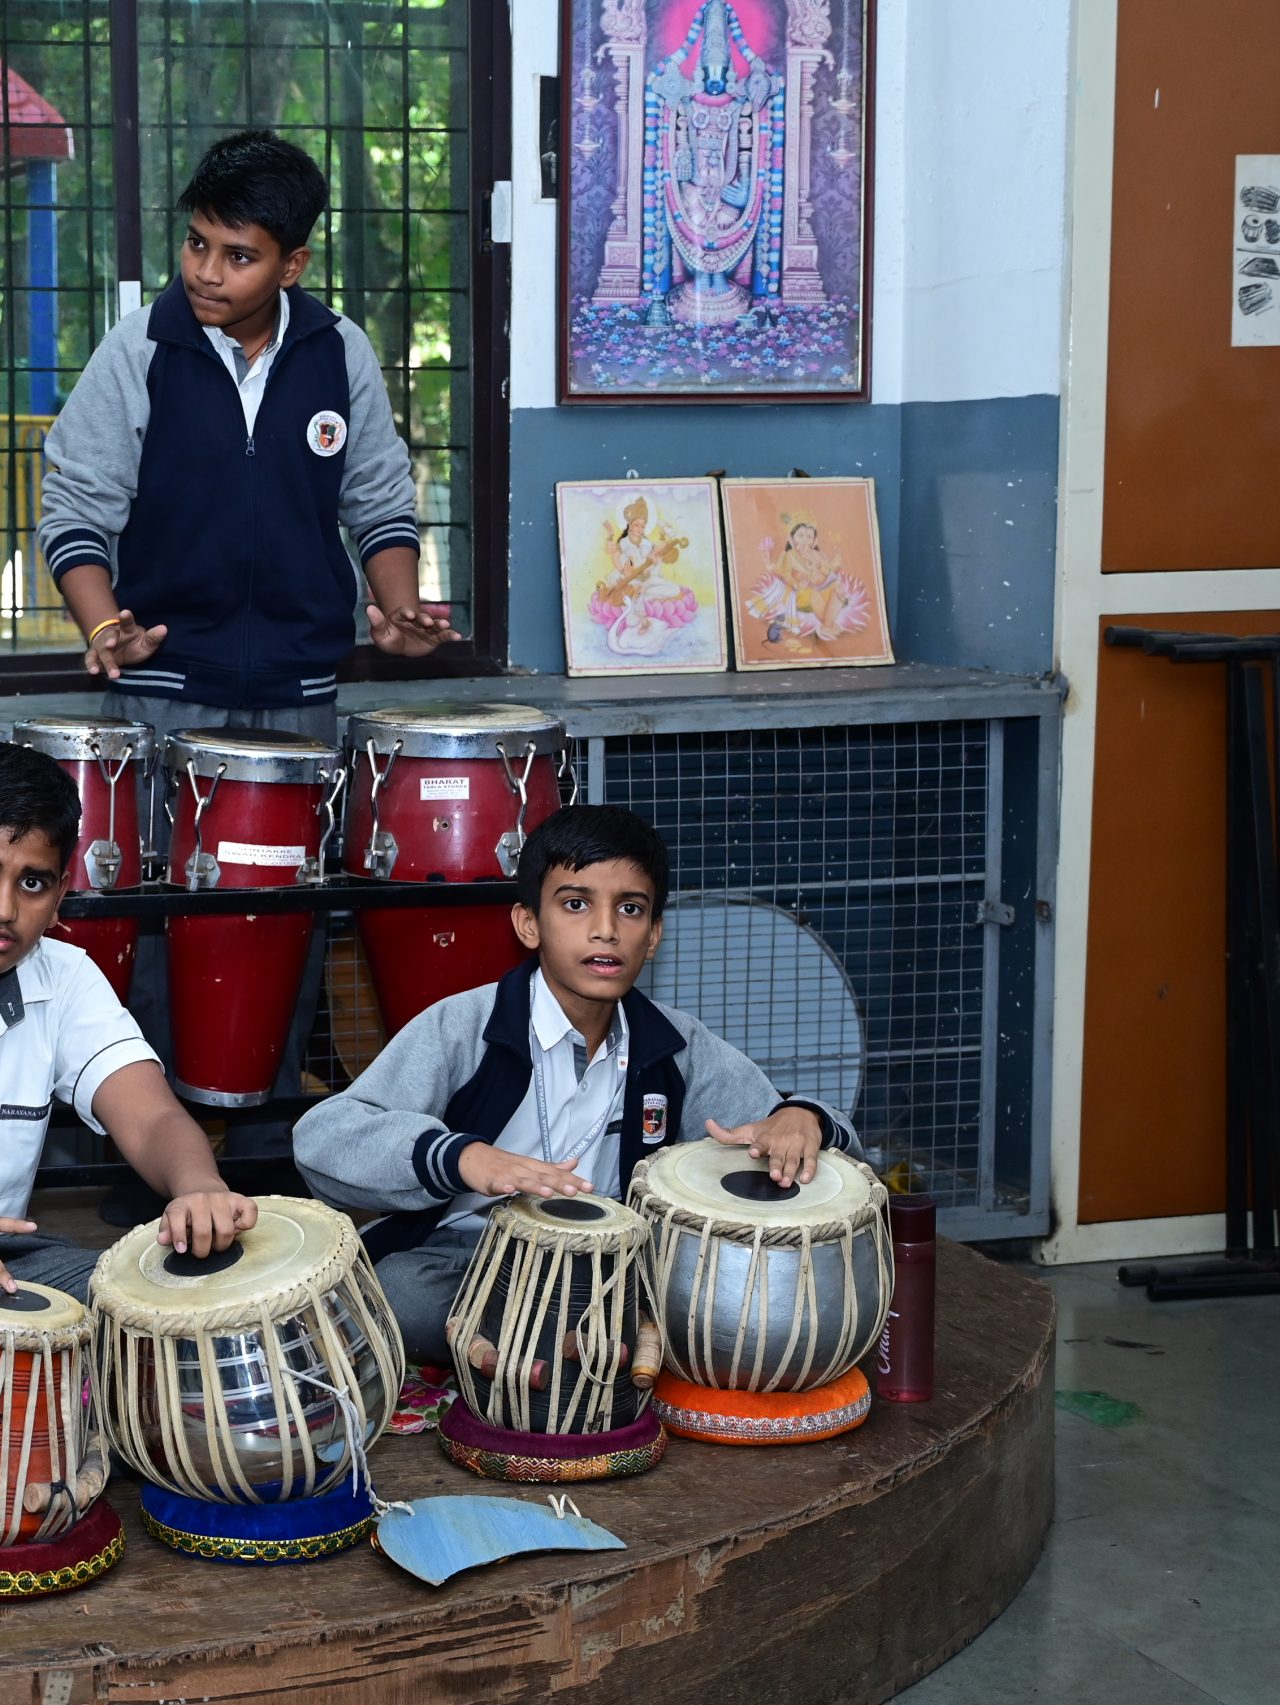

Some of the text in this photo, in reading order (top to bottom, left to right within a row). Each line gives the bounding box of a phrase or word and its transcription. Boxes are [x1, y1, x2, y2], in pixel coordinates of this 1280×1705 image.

[239, 846, 292, 855] ONTAKKE
[536, 1062, 547, 1117] VIDYALAYAM
[1, 1108, 37, 1117] NARAYANA
